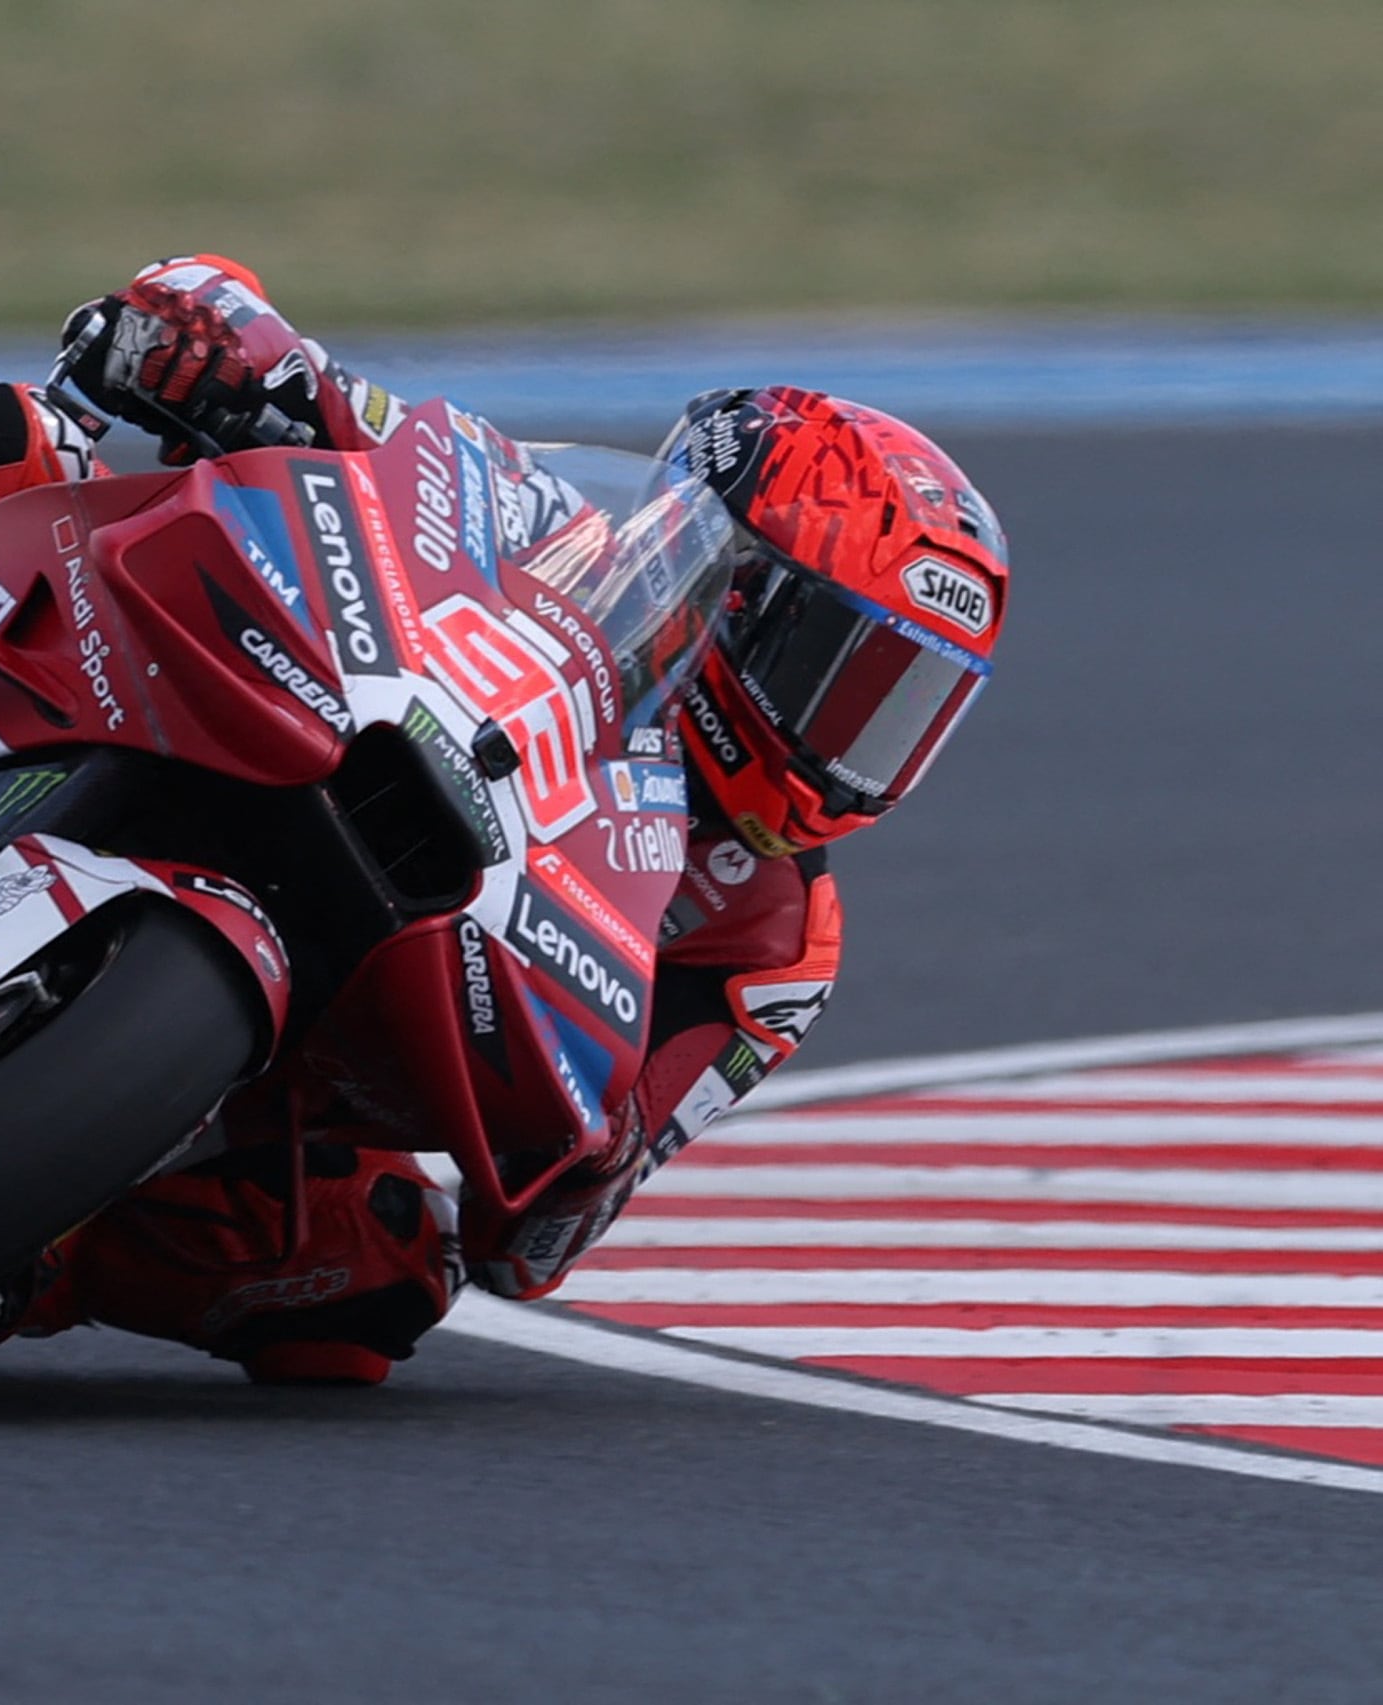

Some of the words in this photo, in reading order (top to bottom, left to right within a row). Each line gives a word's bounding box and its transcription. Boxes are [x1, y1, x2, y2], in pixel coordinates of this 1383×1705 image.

[247, 540, 300, 607] TIM
[302, 474, 379, 664] Lenovo
[919, 568, 986, 626] SHOEI
[65, 556, 95, 630] Audi
[80, 630, 125, 731] Sport
[240, 628, 352, 733] CARRERA
[534, 593, 615, 724] VARGROUP
[460, 920, 496, 1034] CARRERA
[517, 893, 638, 1023] Lenovo
